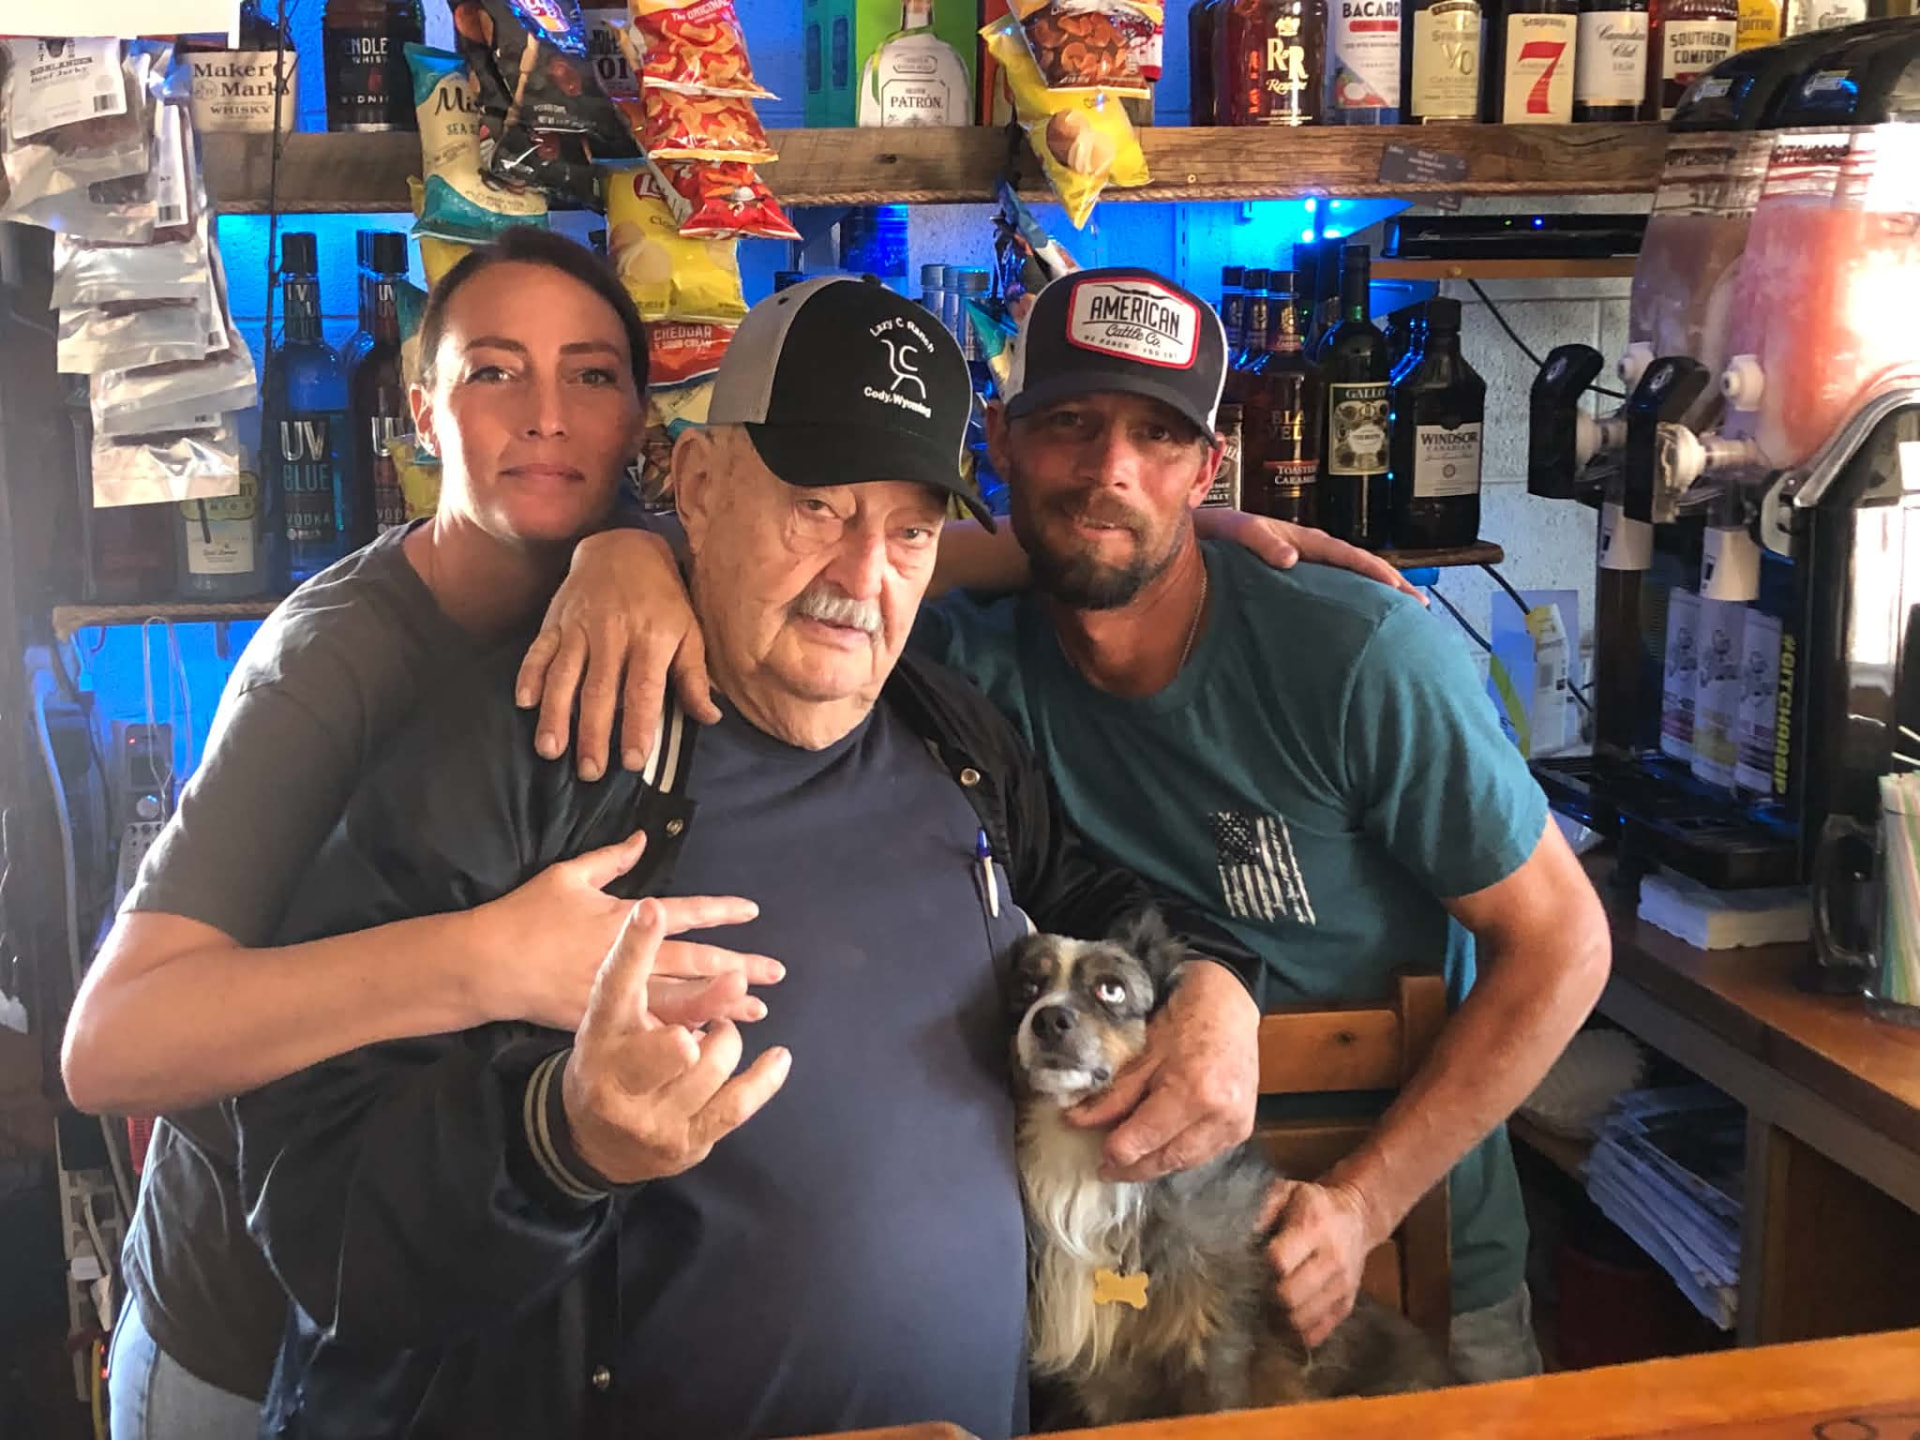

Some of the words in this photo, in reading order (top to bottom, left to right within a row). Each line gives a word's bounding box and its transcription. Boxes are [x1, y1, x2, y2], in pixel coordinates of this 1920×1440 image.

[1669, 32, 1731, 48] SOUTHERN
[1518, 41, 1567, 114] 7
[210, 105, 271, 114] WHISKY
[1090, 296, 1180, 338] AMERICAN
[653, 326, 712, 341] CHEDDAR
[870, 320, 893, 337] Lazy
[1105, 323, 1144, 342] Cattle
[1345, 388, 1386, 399] GALLO
[281, 421, 326, 461] UV
[1421, 431, 1478, 446] WINDSOR
[283, 464, 331, 491] BLUE
[285, 512, 331, 527] VODKA
